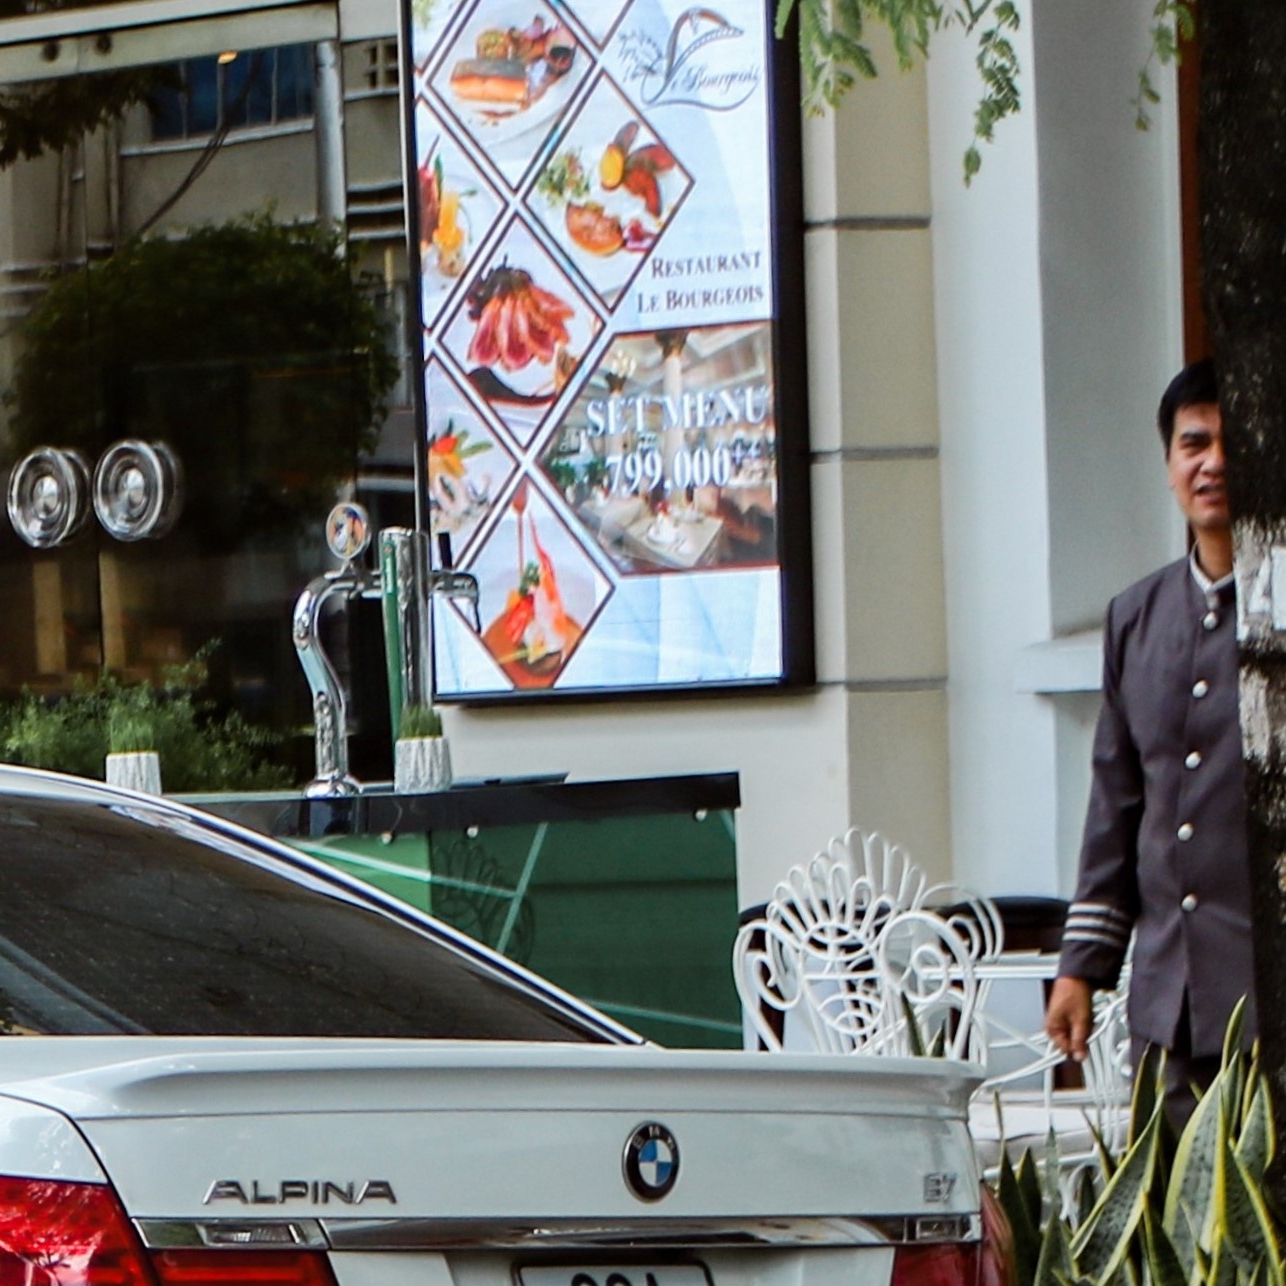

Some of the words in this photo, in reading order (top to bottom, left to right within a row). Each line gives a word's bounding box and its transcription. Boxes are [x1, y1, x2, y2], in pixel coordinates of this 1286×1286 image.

[651, 250, 761, 279] RESTAURANT
[666, 284, 764, 311] BOURGEOIS
[586, 394, 653, 437] SET
[658, 383, 768, 431] MENU
[202, 1179, 398, 1205] ALPINA
